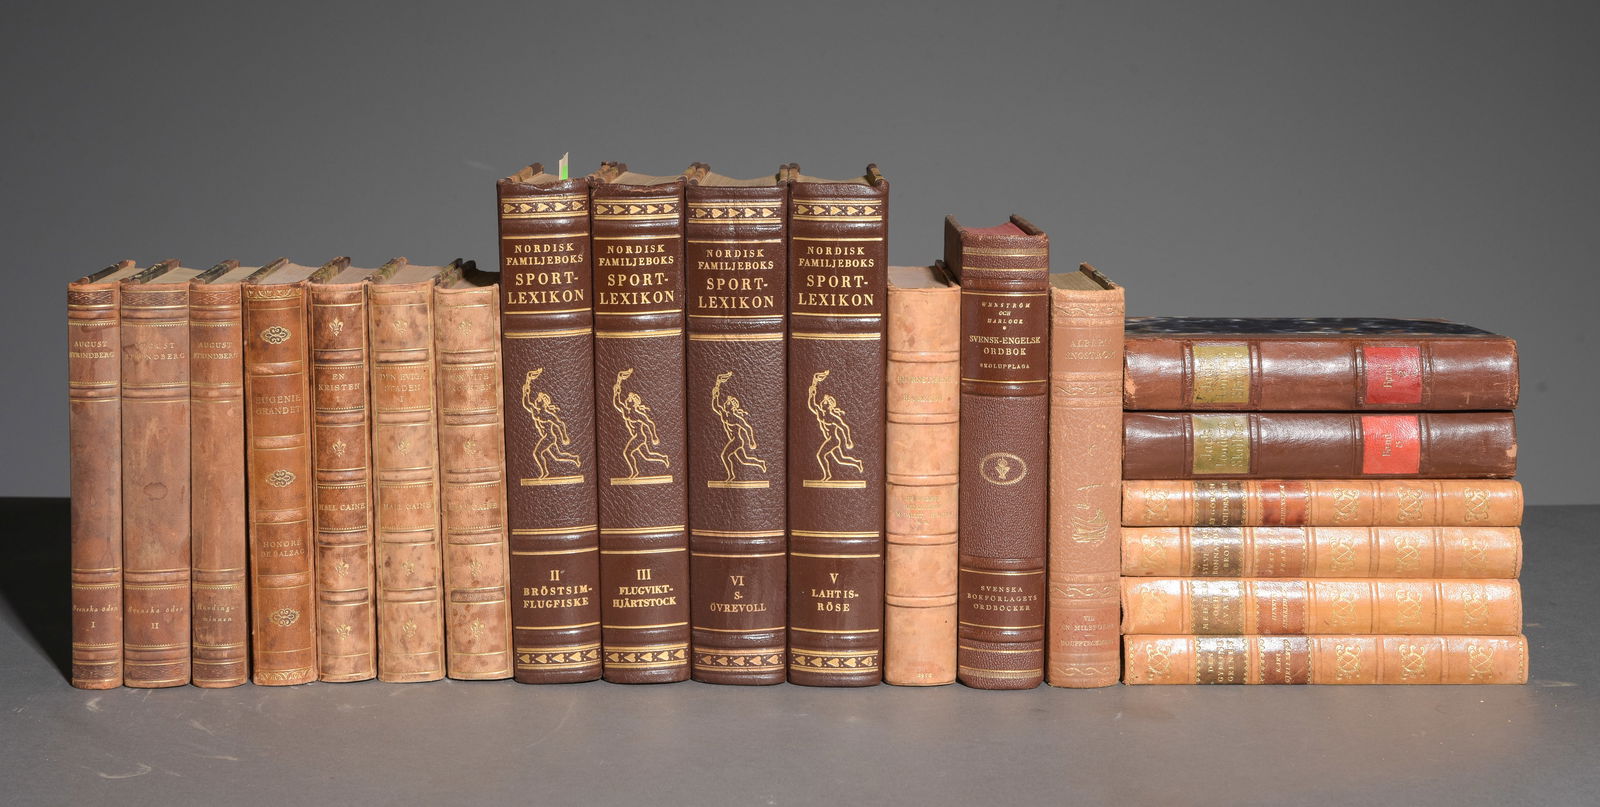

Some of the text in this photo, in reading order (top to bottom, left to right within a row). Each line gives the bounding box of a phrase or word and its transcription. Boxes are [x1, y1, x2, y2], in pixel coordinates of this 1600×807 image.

[514, 242, 575, 254] NORDISK
[607, 244, 665, 254] NORDISK
[706, 248, 765, 258] NORDISK
[806, 246, 865, 256] NORDISK
[505, 253, 584, 266] FAMILJEBOKS
[598, 255, 674, 267] FAMILJEBOKS
[697, 260, 774, 271] FAMILJEBOKS
[798, 257, 875, 268] FAMILJEBOKS
[515, 271, 579, 286] SPORT-
[607, 272, 669, 287] SPORT-
[706, 277, 769, 291] SPORT-
[806, 274, 869, 288] SPORT-
[507, 288, 584, 305] LEXIKON
[599, 290, 675, 305] LEXIKON
[698, 295, 774, 309] LEXIKON
[798, 292, 875, 307] LEXIKON
[74, 340, 108, 348] AUGUST
[969, 335, 1041, 345] SVENSK-ENGELSK
[125, 352, 186, 361] NDBERG
[983, 347, 1027, 356] ORDBOK
[318, 383, 360, 391] KRISTEN
[255, 394, 302, 405] EUGENIE
[256, 406, 301, 416] GRANDET
[340, 502, 366, 511] CAINE
[549, 569, 560, 582] II
[636, 568, 652, 581] III
[829, 572, 839, 585] V
[730, 575, 745, 587] VI
[523, 585, 593, 597] BRÖSTSIM-
[618, 584, 674, 596] FLUGVIKT-
[980, 585, 1024, 593] SVENSKA
[733, 591, 744, 600] S-
[523, 597, 589, 609] FLUGFISKE
[612, 596, 677, 608] HJÄRTSTOCK
[817, 602, 851, 612] RÖSE
[91, 621, 96, 629] I
[151, 622, 160, 630] II
